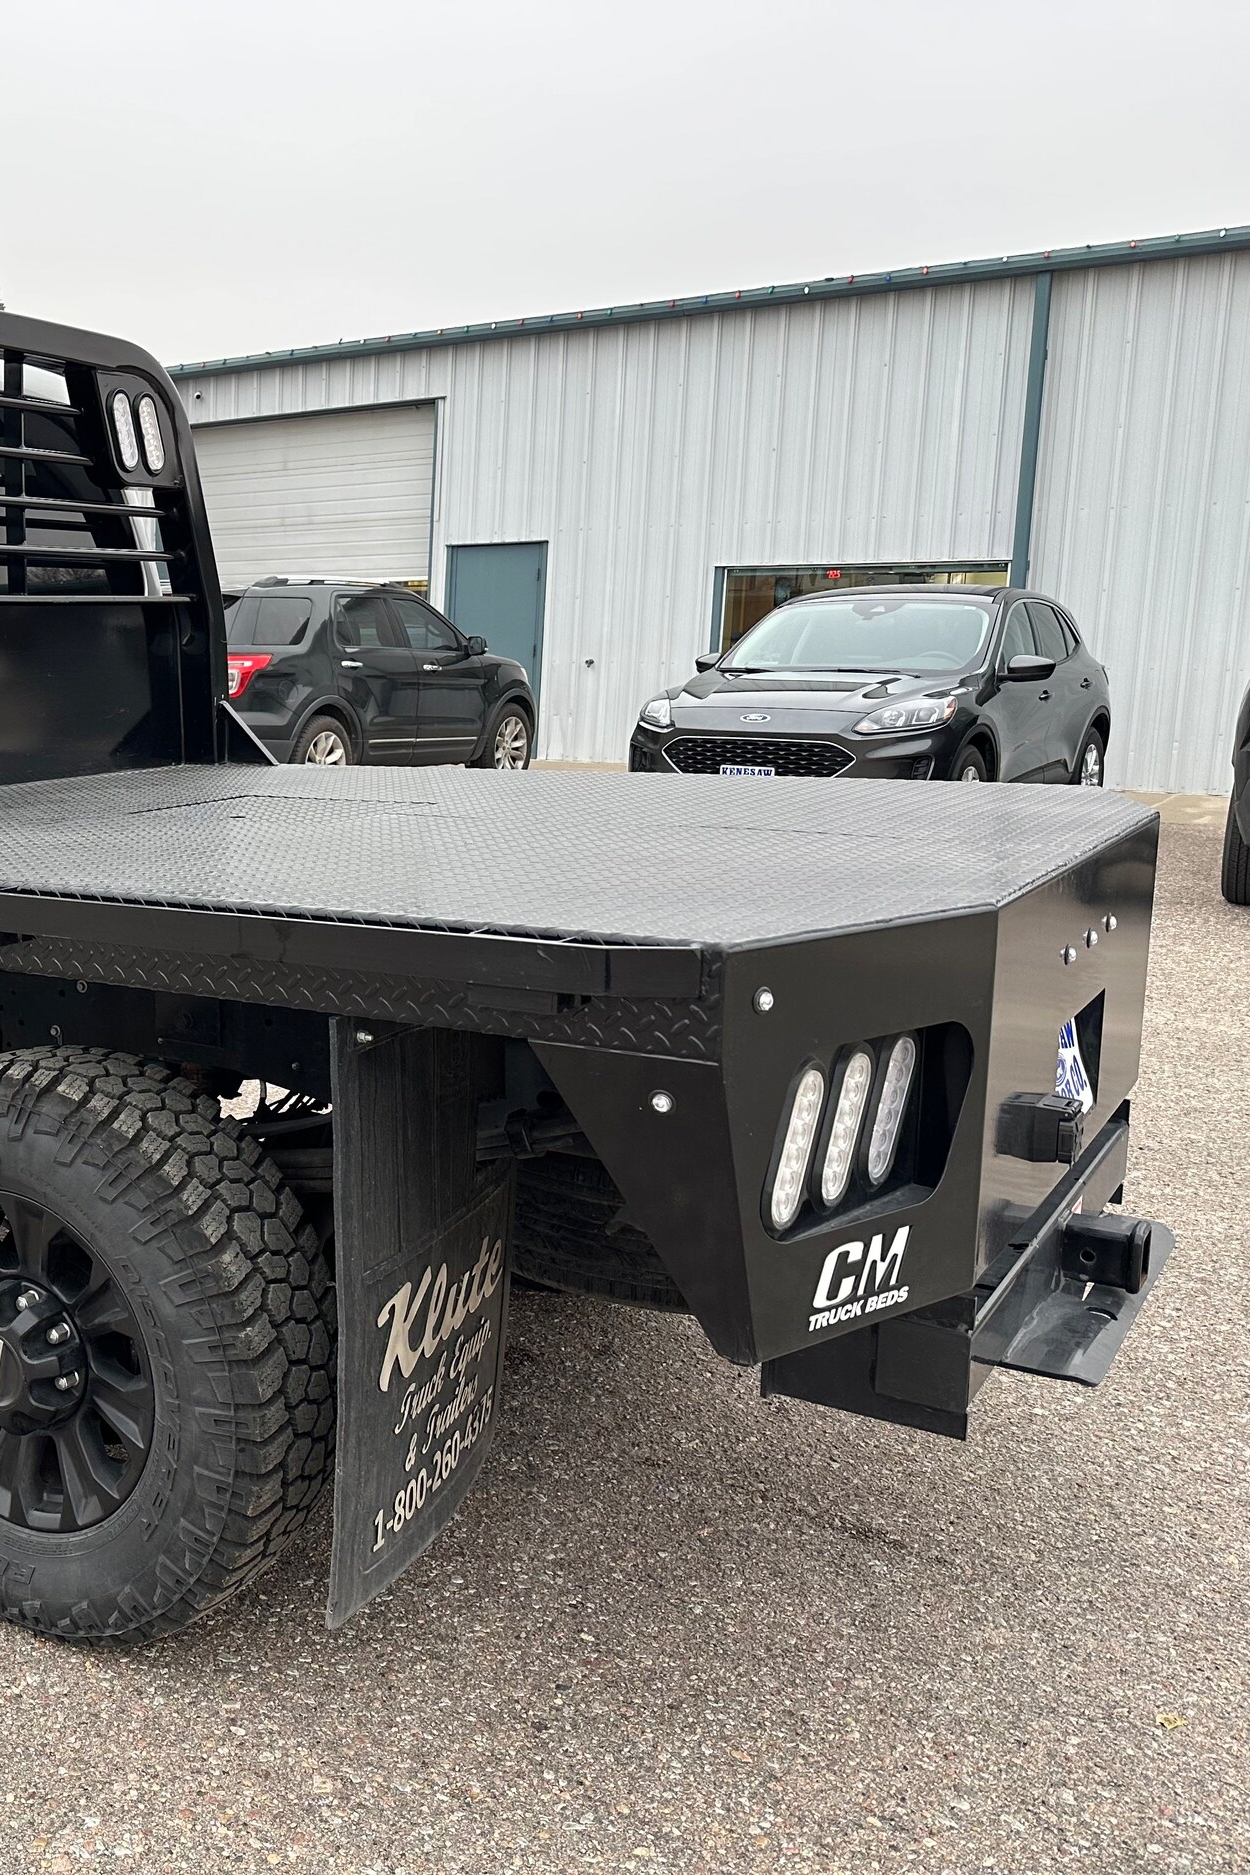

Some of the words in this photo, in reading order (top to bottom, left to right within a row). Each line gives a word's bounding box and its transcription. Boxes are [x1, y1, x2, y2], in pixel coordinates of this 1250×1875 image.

[721, 766, 773, 777] KENESAW
[377, 1236, 504, 1392] Klute
[808, 1299, 864, 1332] TRUCK
[865, 1286, 909, 1314] BEDS
[813, 1225, 910, 1309] CM
[116, 1255, 181, 1541] DISCOVERER
[395, 1350, 447, 1434] Truck
[450, 1317, 491, 1382] Equip.
[405, 1432, 417, 1472] &
[422, 1374, 478, 1454] Trailers
